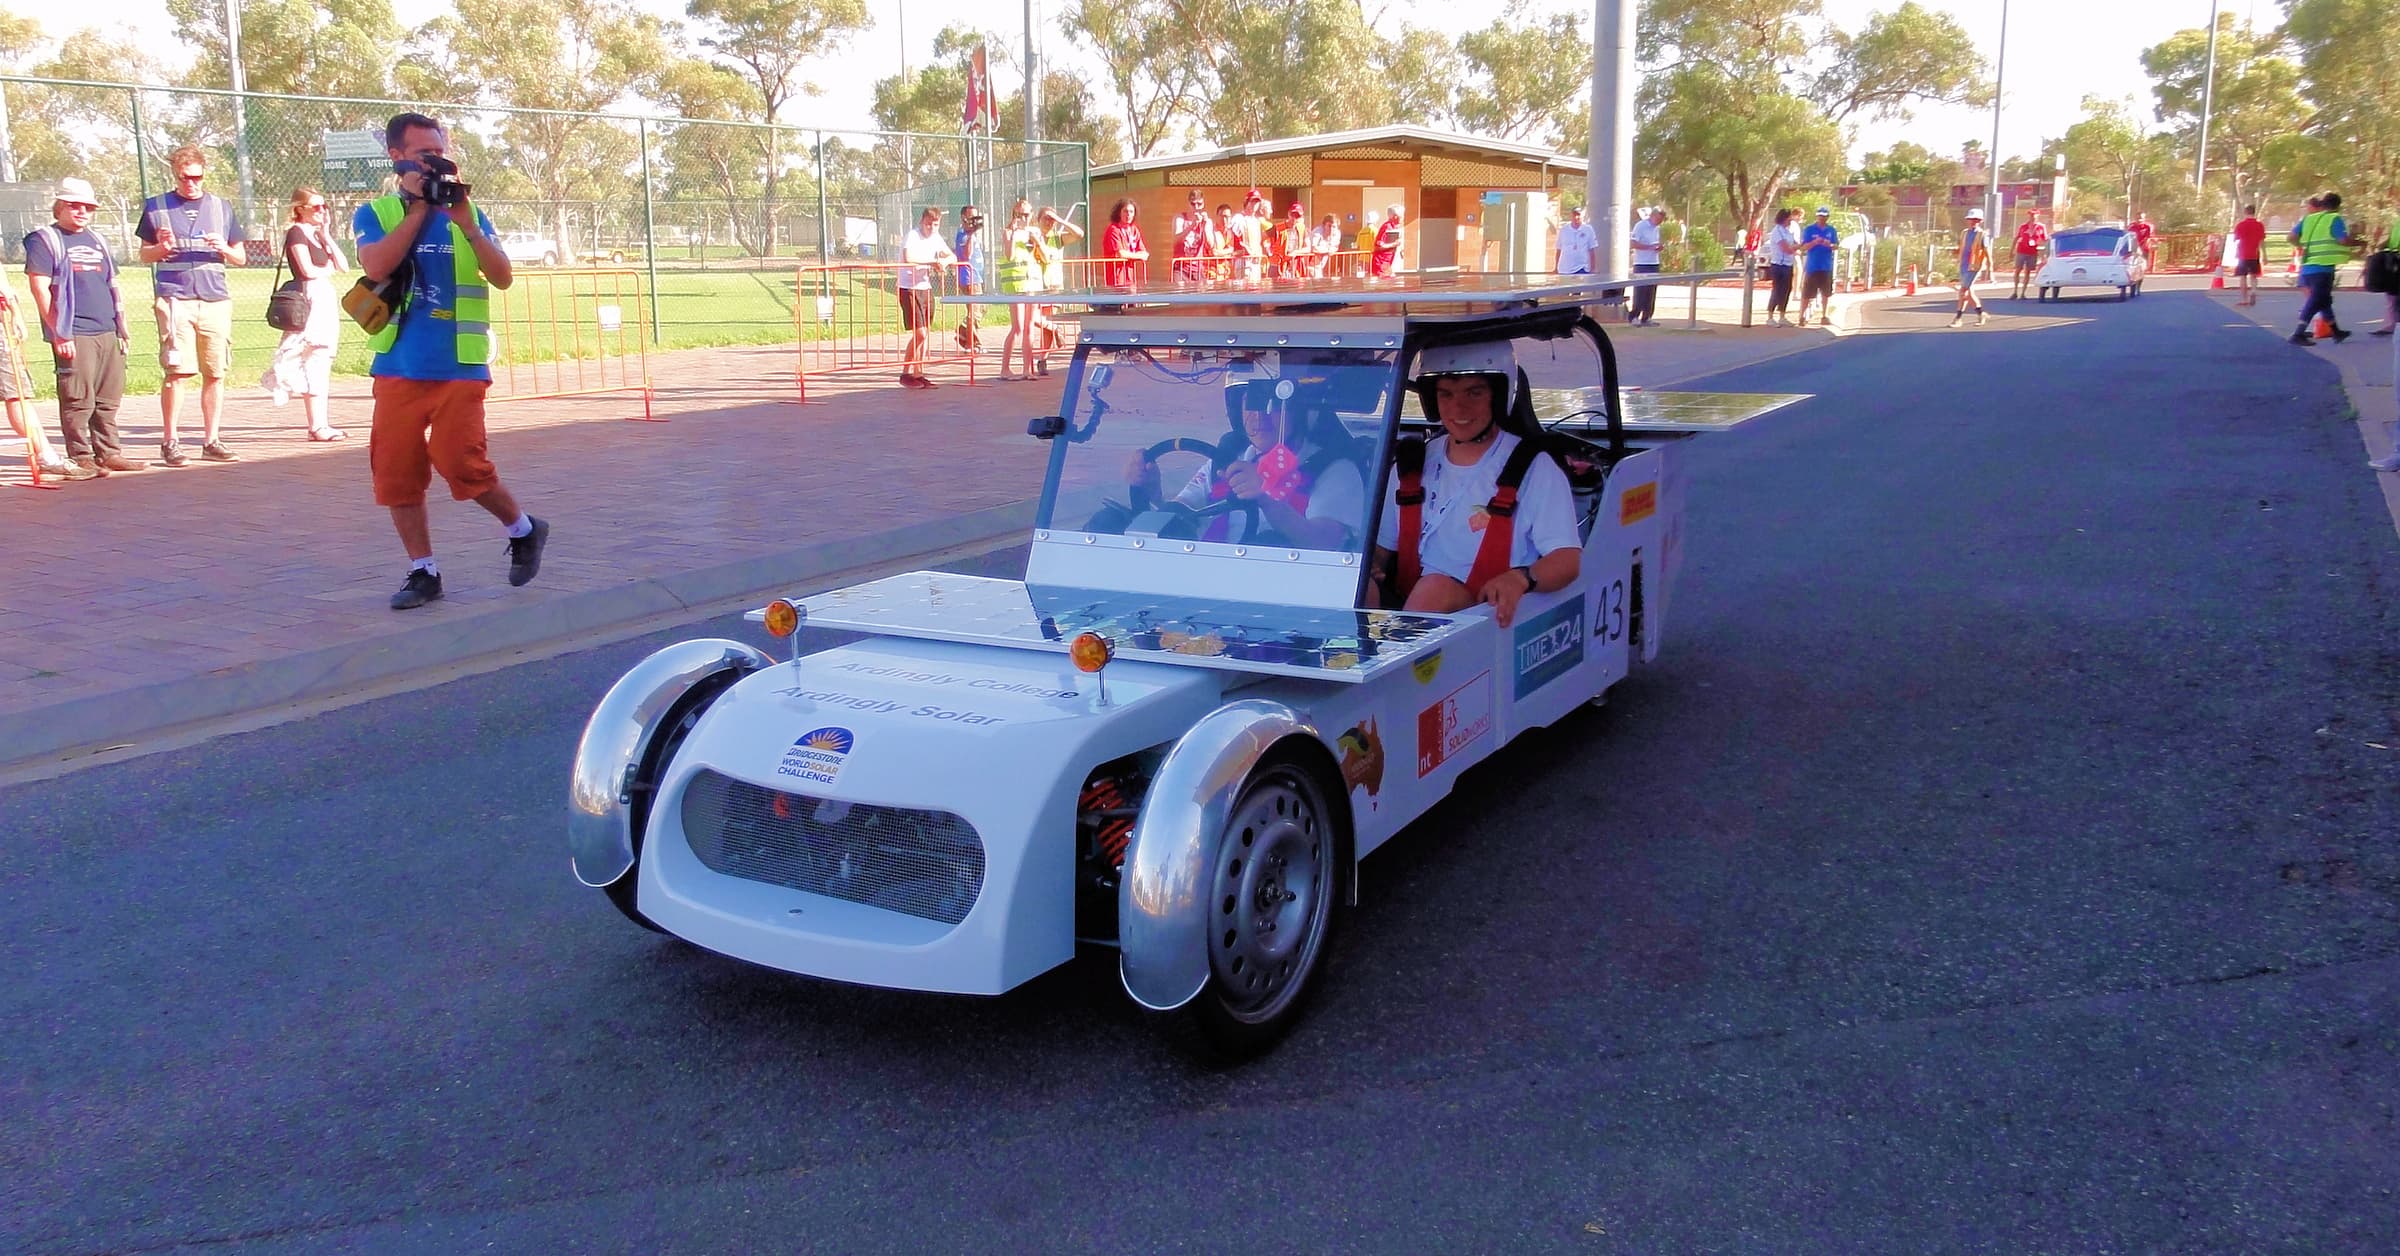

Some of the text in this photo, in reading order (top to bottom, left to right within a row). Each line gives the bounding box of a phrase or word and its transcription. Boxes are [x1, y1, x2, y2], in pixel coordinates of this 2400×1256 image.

[324, 160, 348, 170] HOME
[1594, 579, 1623, 646] 43
[1517, 634, 1549, 670] TIME
[832, 662, 1080, 699] Ardingly College
[771, 686, 1006, 726] Ardingly Solar
[786, 747, 845, 765] BRIDGESTONE
[1420, 752, 1431, 773] nt
[777, 766, 836, 784] CHALLENGE
